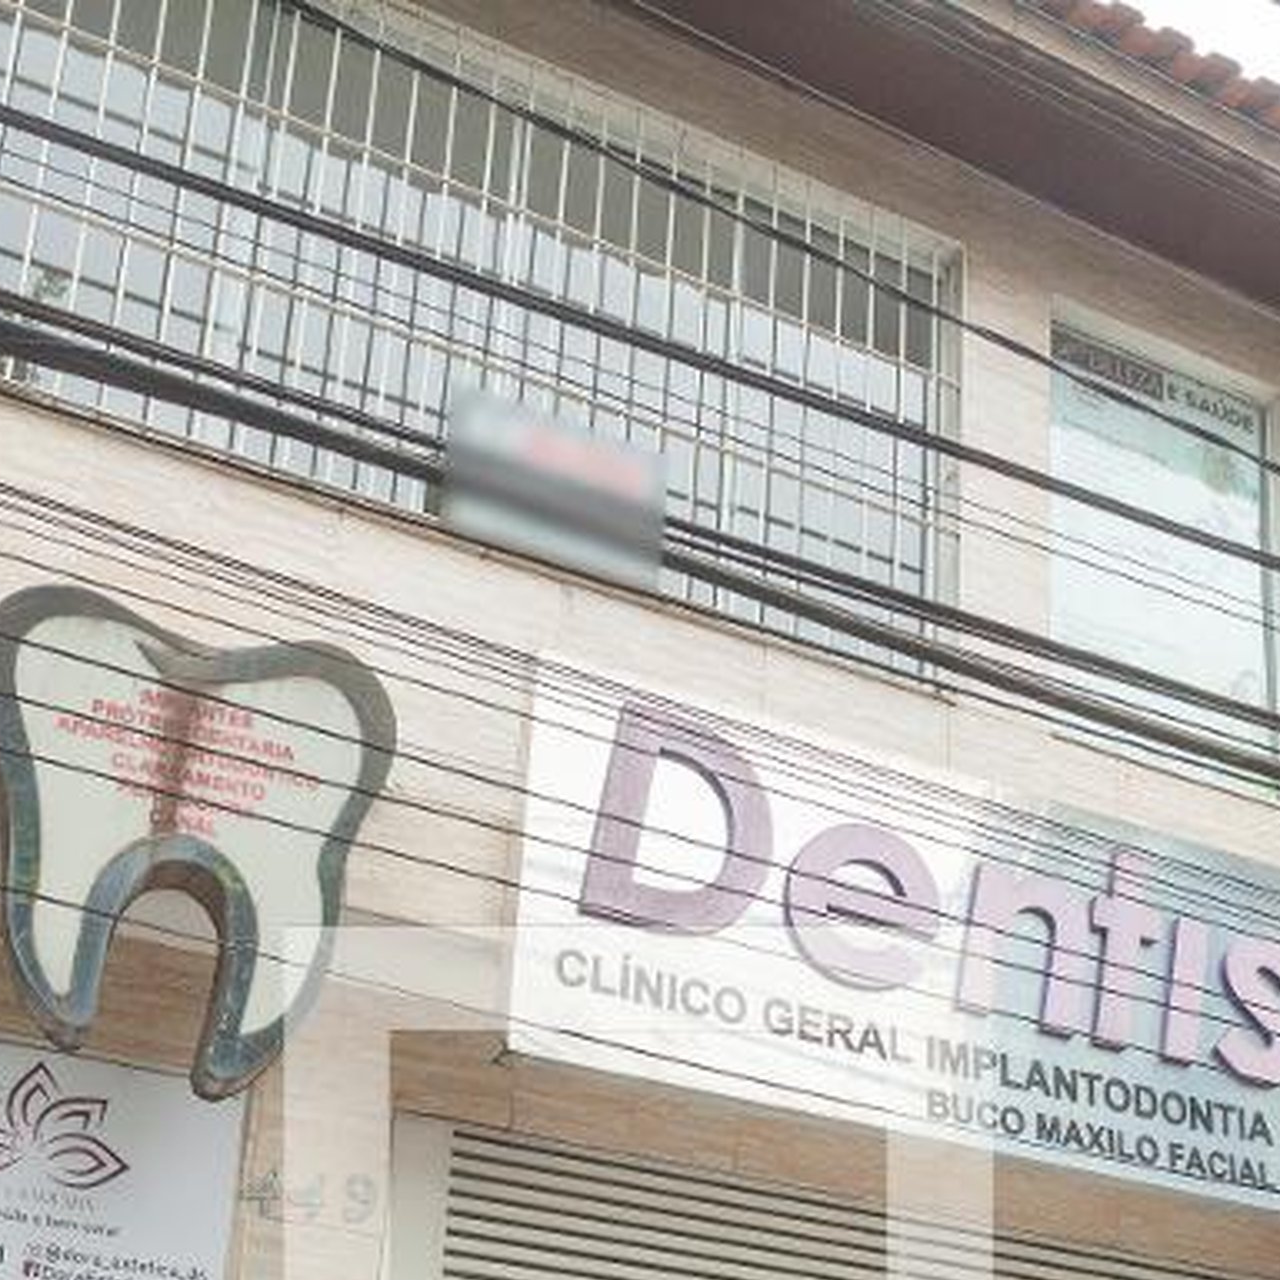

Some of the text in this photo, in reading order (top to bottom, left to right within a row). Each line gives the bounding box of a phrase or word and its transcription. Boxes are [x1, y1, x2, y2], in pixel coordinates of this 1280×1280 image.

[555, 948, 747, 1025] CLÍNICO
[762, 998, 913, 1063] GERAL
[926, 1036, 1274, 1148] IMPLANTODONTIA
[926, 1088, 1276, 1192] BUCO MAXILO FACIAL
